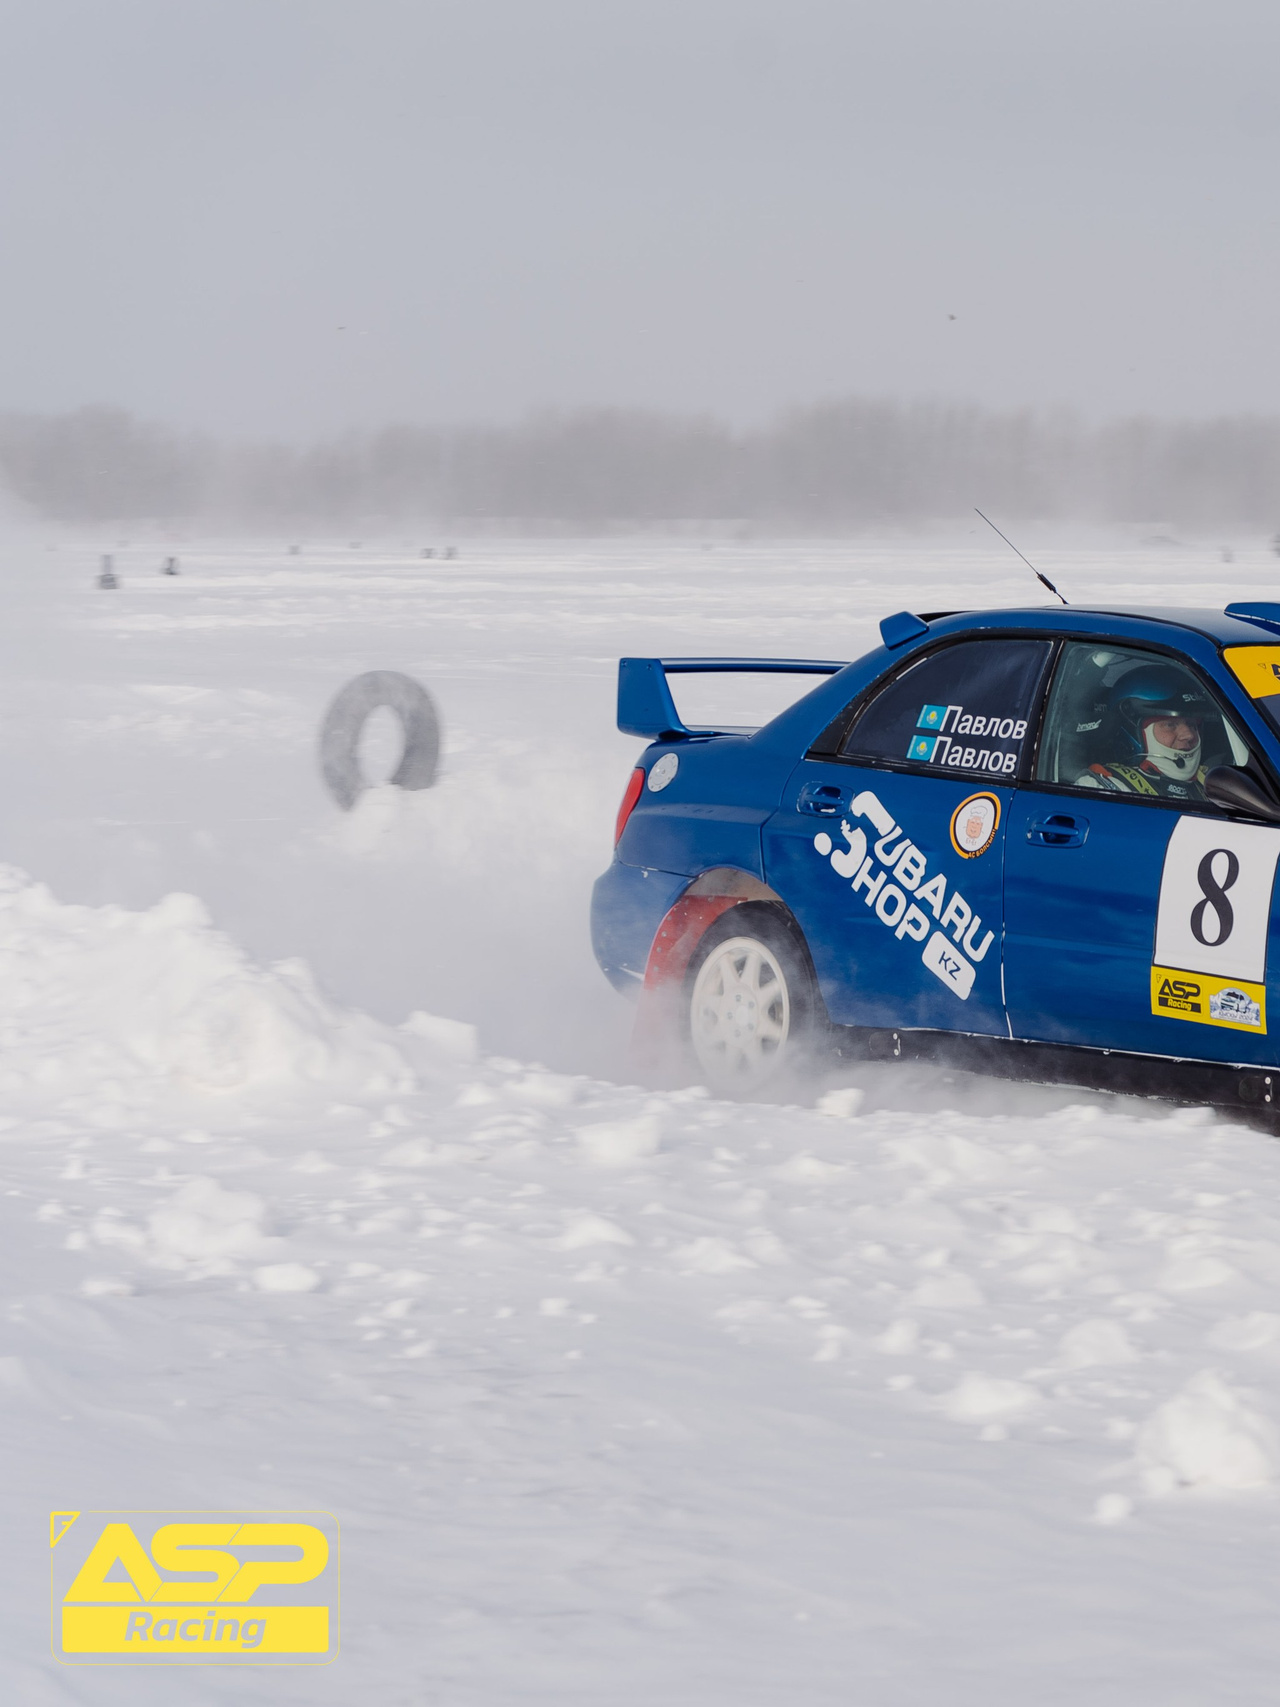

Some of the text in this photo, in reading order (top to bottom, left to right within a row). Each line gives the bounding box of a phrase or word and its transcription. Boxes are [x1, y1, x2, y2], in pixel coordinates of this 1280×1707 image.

[940, 705, 1028, 740] Павлов
[930, 736, 1018, 774] Павлов
[829, 791, 995, 962] SUBARU
[1190, 848, 1239, 946] 8
[938, 951, 961, 981] KZ
[1159, 978, 1200, 999] ASP
[1167, 998, 1192, 1011] Racing
